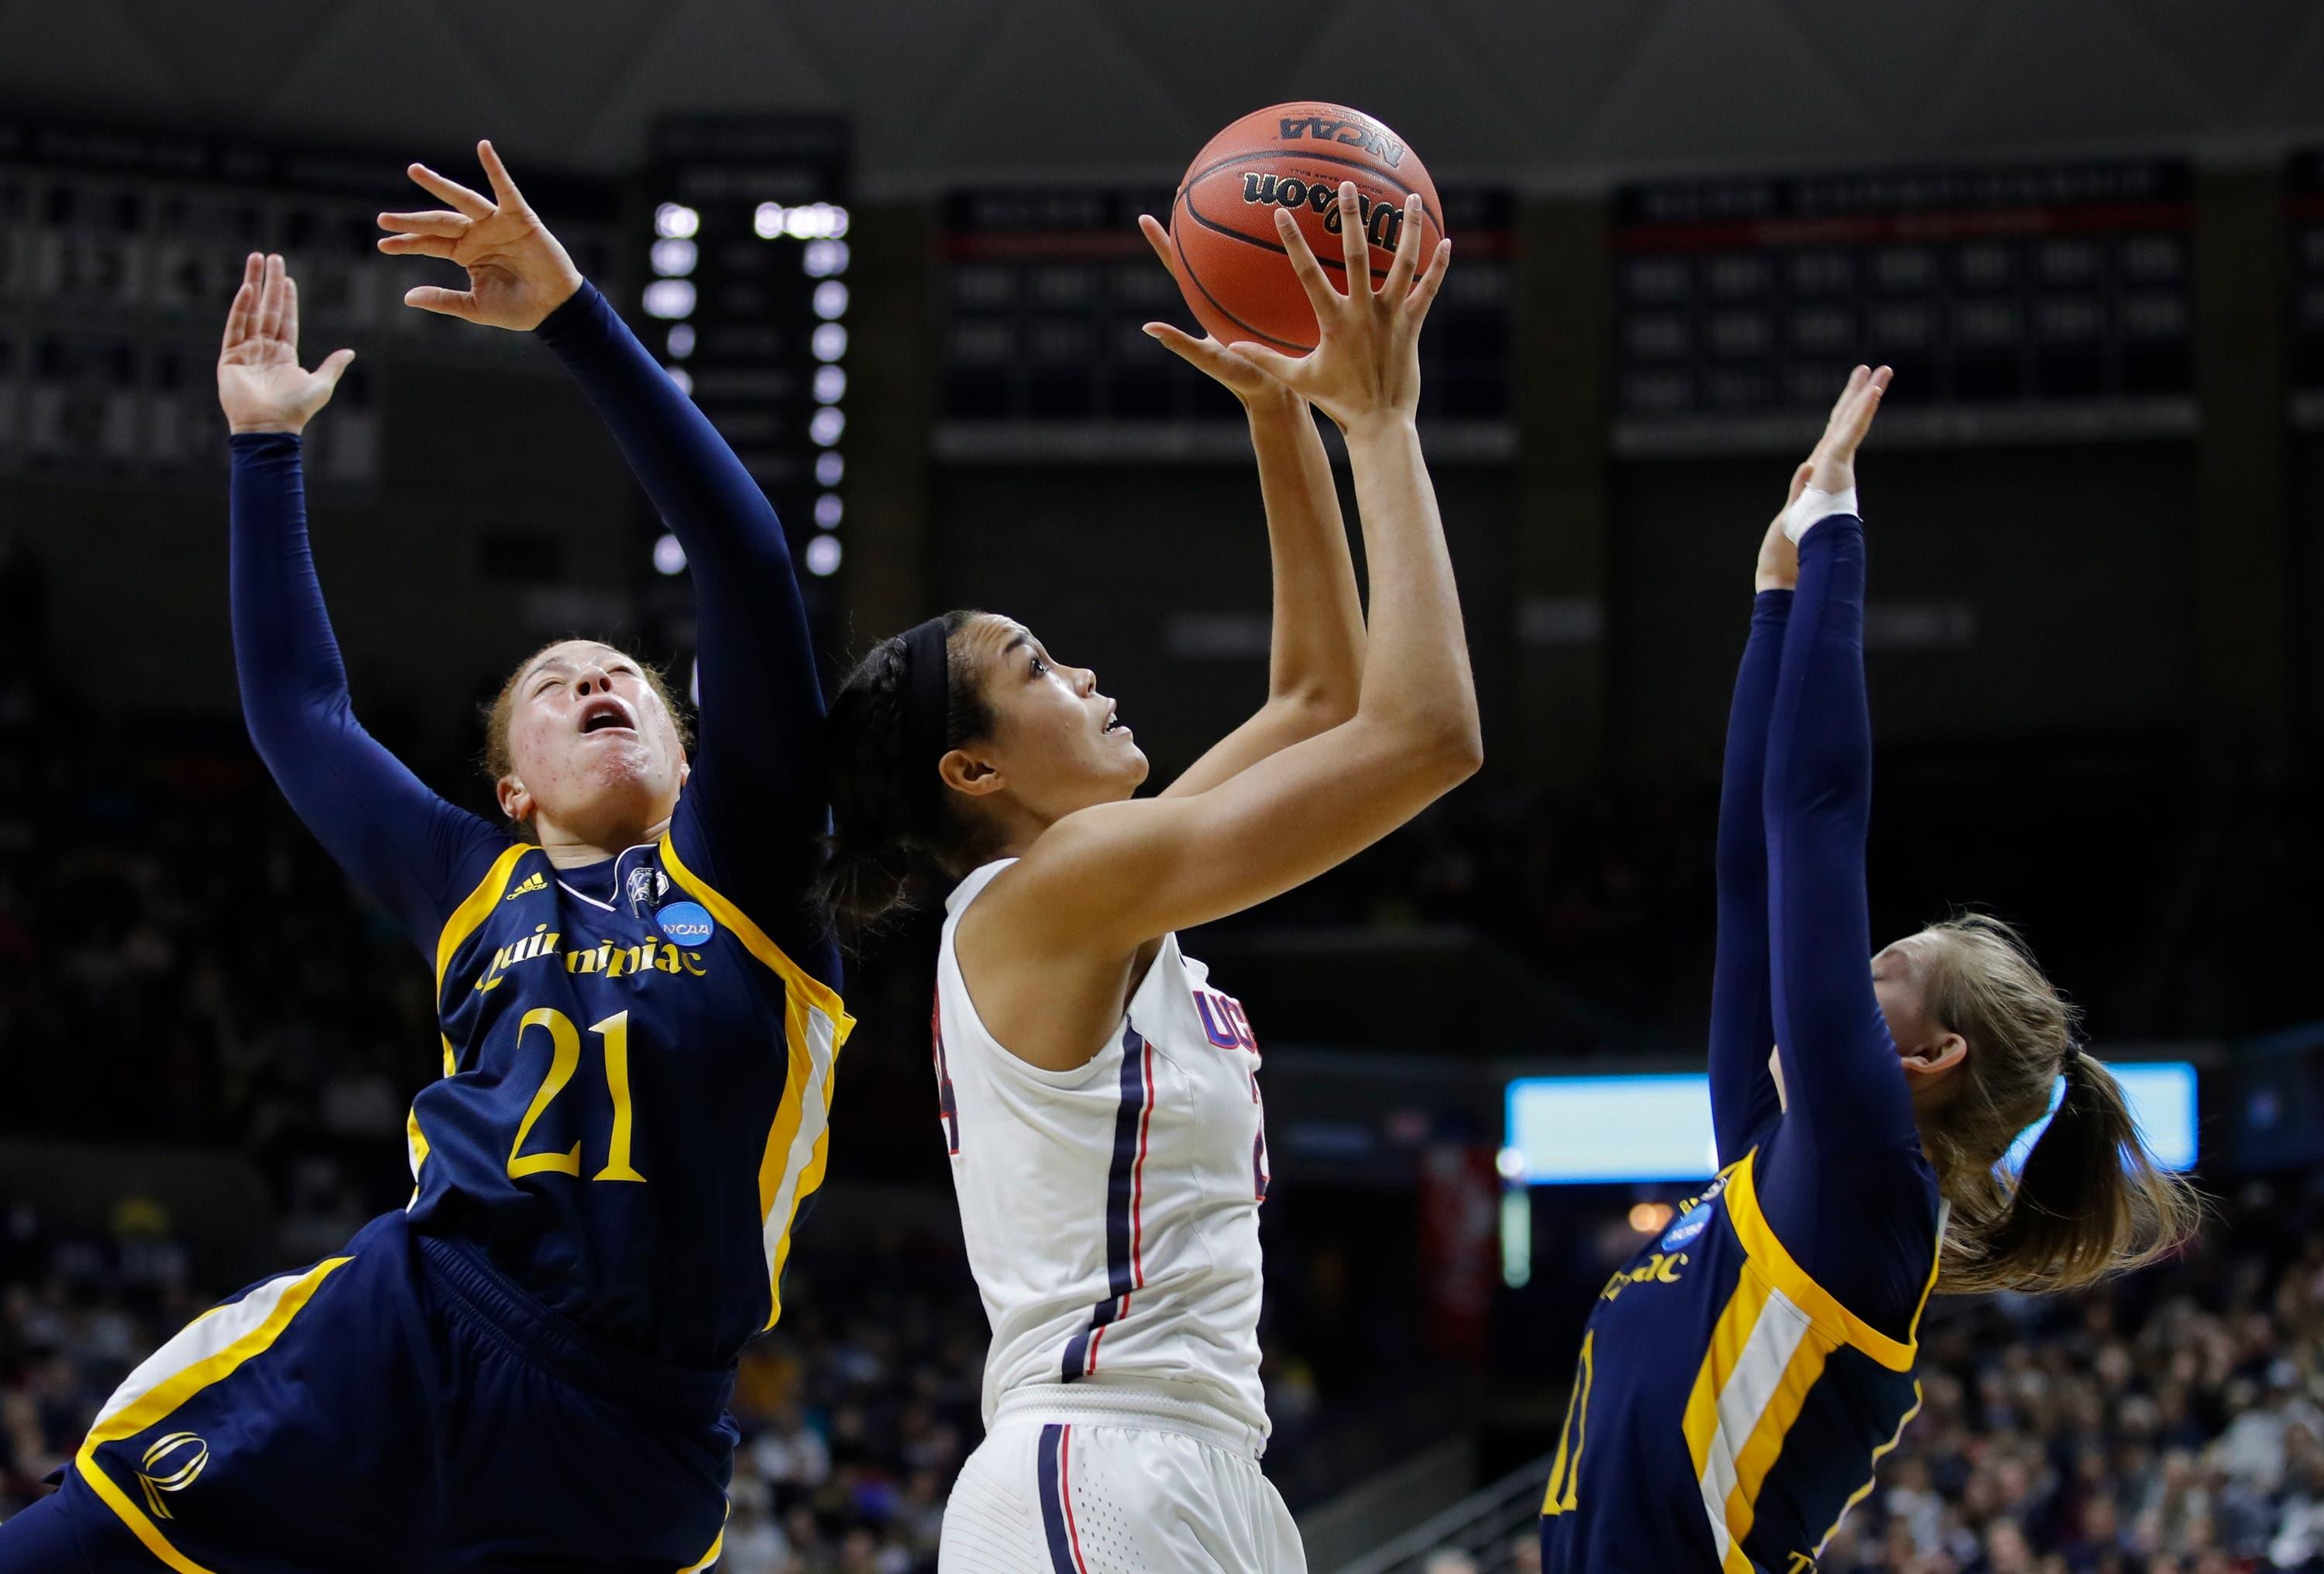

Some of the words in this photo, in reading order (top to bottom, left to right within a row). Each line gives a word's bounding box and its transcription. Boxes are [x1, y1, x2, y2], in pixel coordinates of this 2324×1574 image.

[1280, 117, 1405, 168] NCAA
[662, 923, 710, 936] NCAA
[507, 1007, 648, 1183] 21
